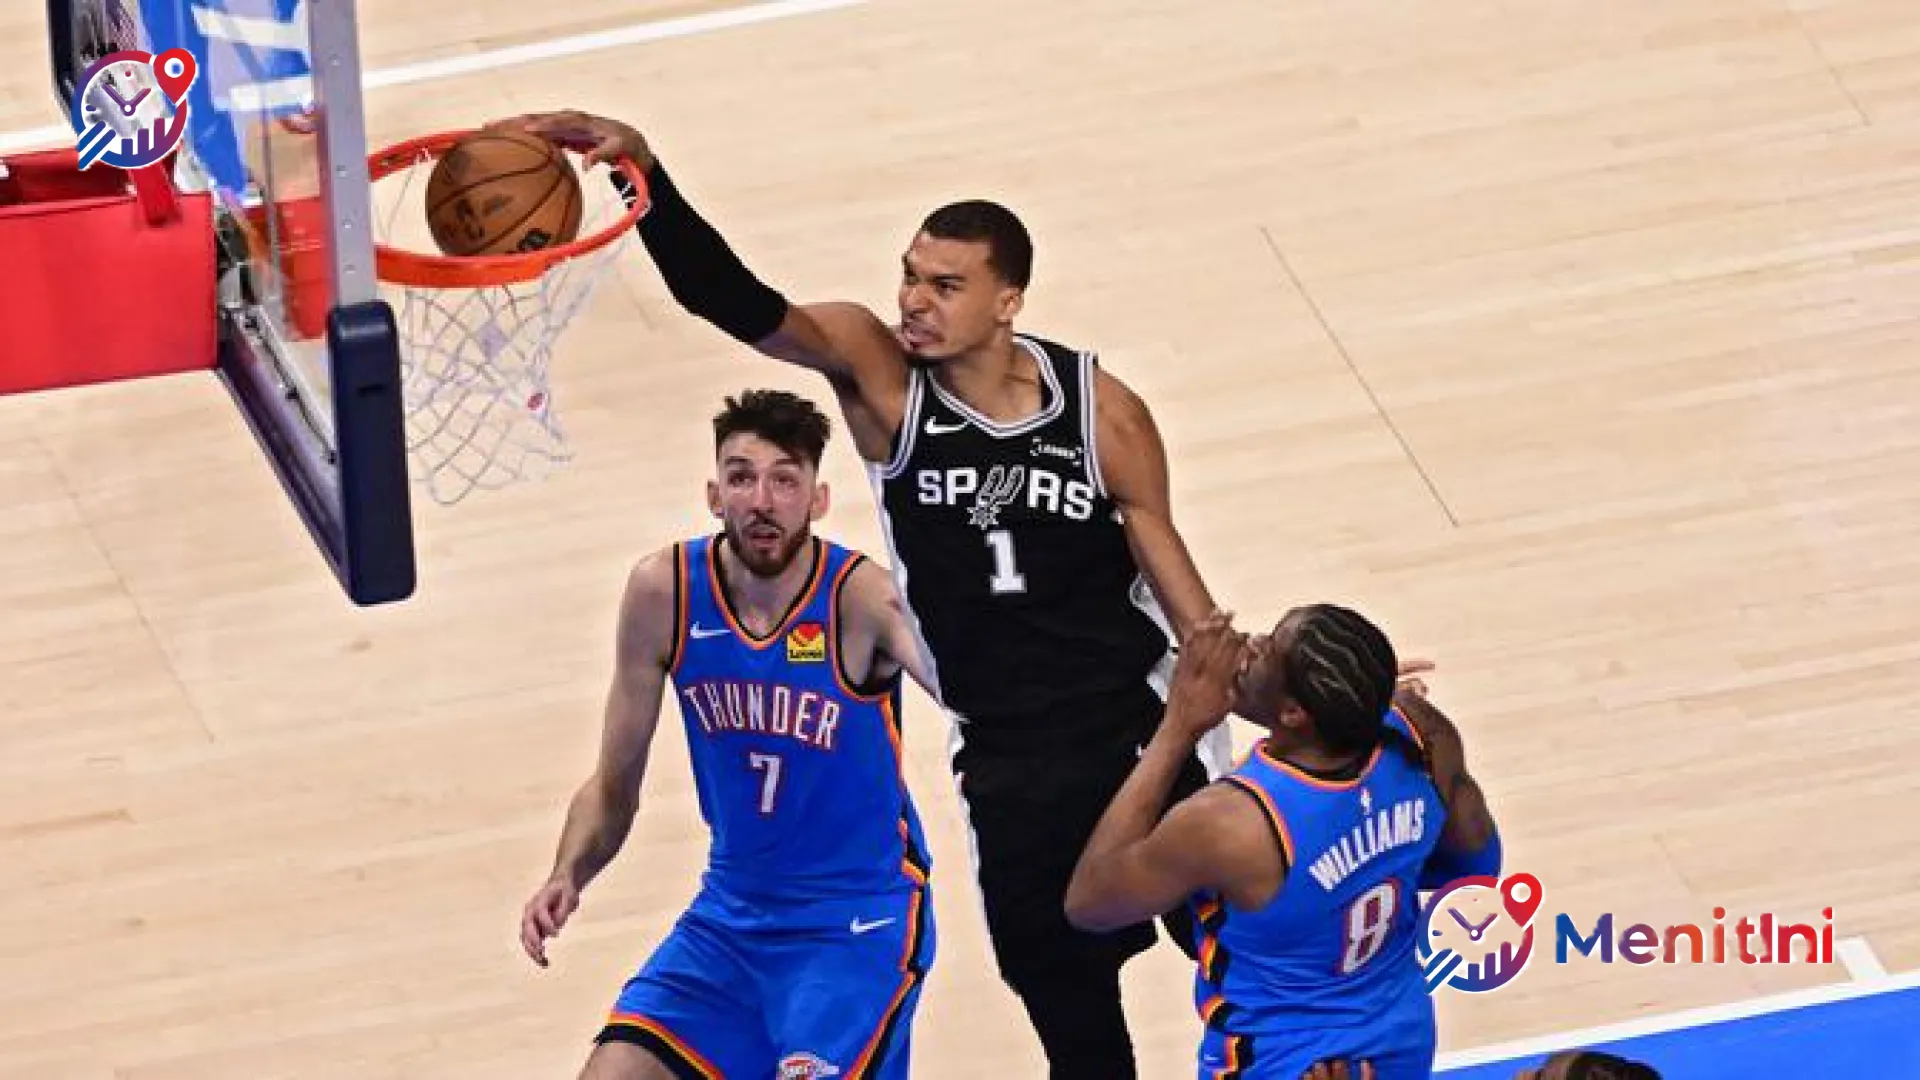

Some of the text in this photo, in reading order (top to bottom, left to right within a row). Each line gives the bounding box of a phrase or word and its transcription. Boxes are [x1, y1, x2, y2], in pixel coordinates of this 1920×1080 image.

[917, 464, 1096, 525] SPURS
[985, 529, 1028, 595] 1
[683, 682, 841, 751] THUNDER
[749, 751, 783, 815] 7
[1308, 797, 1426, 891] WILLIAMS
[1341, 878, 1398, 976] 8
